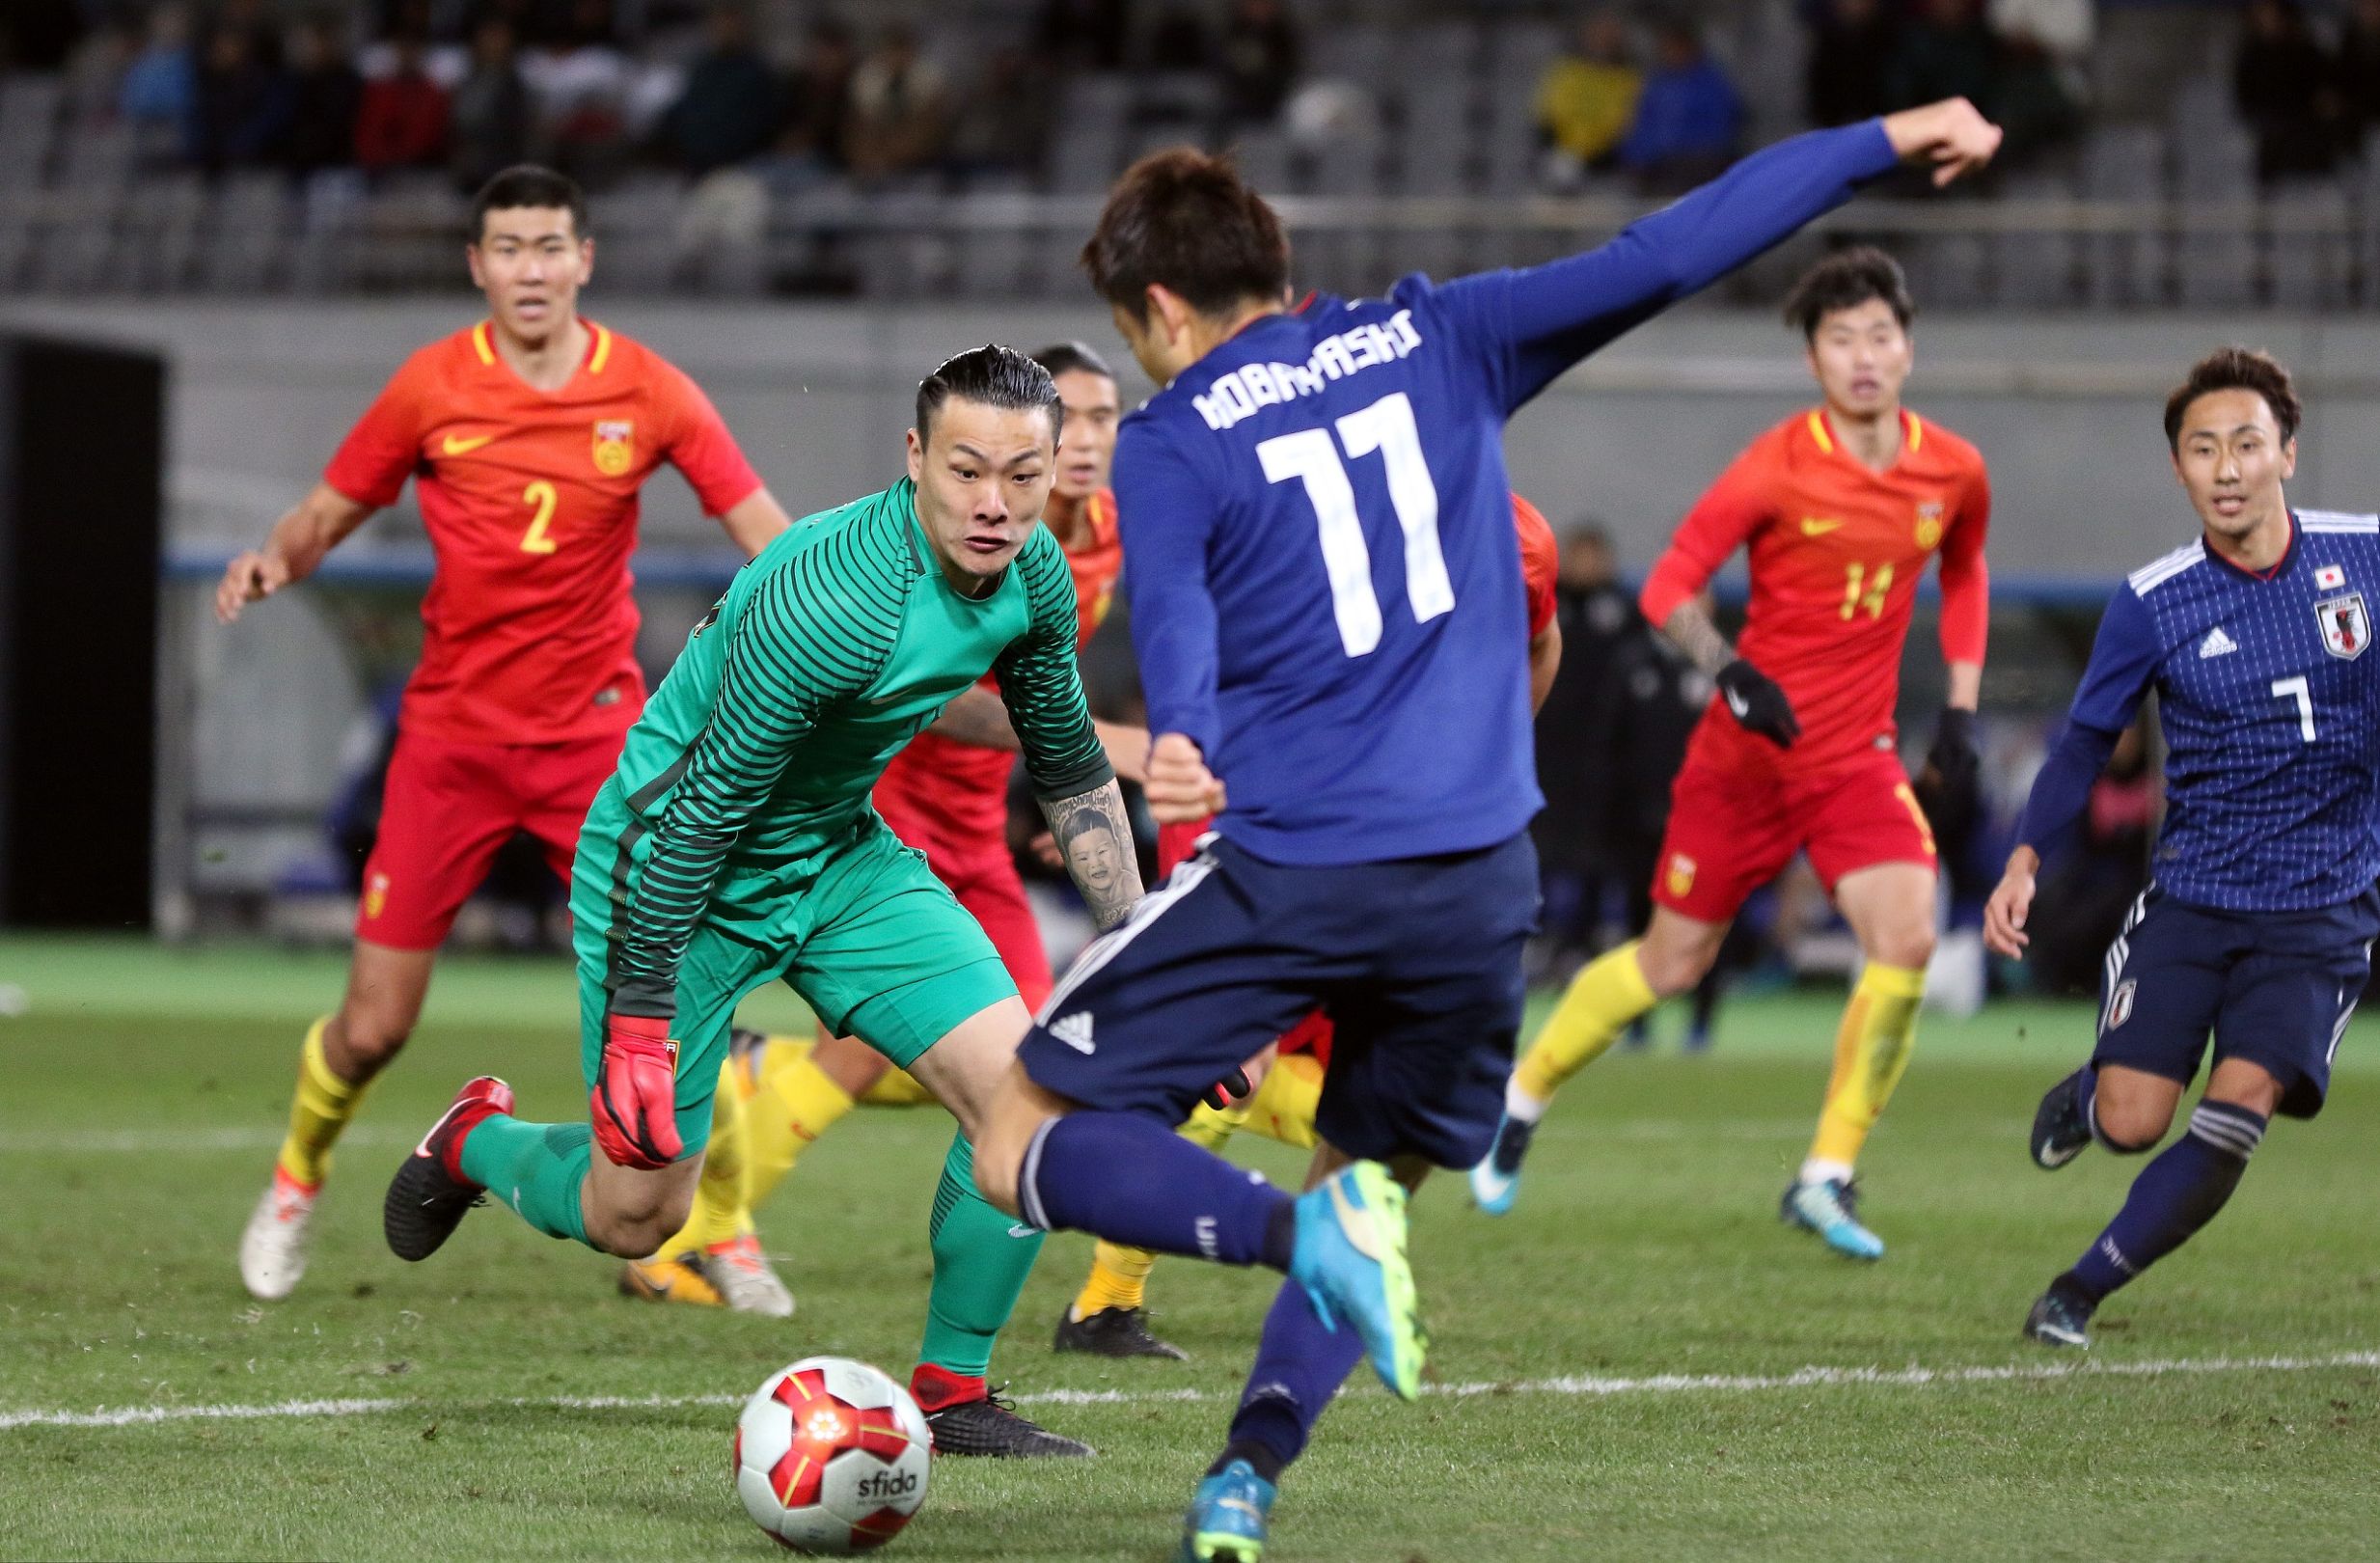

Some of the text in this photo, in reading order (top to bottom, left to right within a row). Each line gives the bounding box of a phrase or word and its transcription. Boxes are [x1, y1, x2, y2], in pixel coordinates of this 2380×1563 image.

[520, 481, 557, 555] 2
[1840, 562, 1895, 620] 14
[2271, 675, 2316, 742] 7
[858, 1468, 917, 1496] sfida
